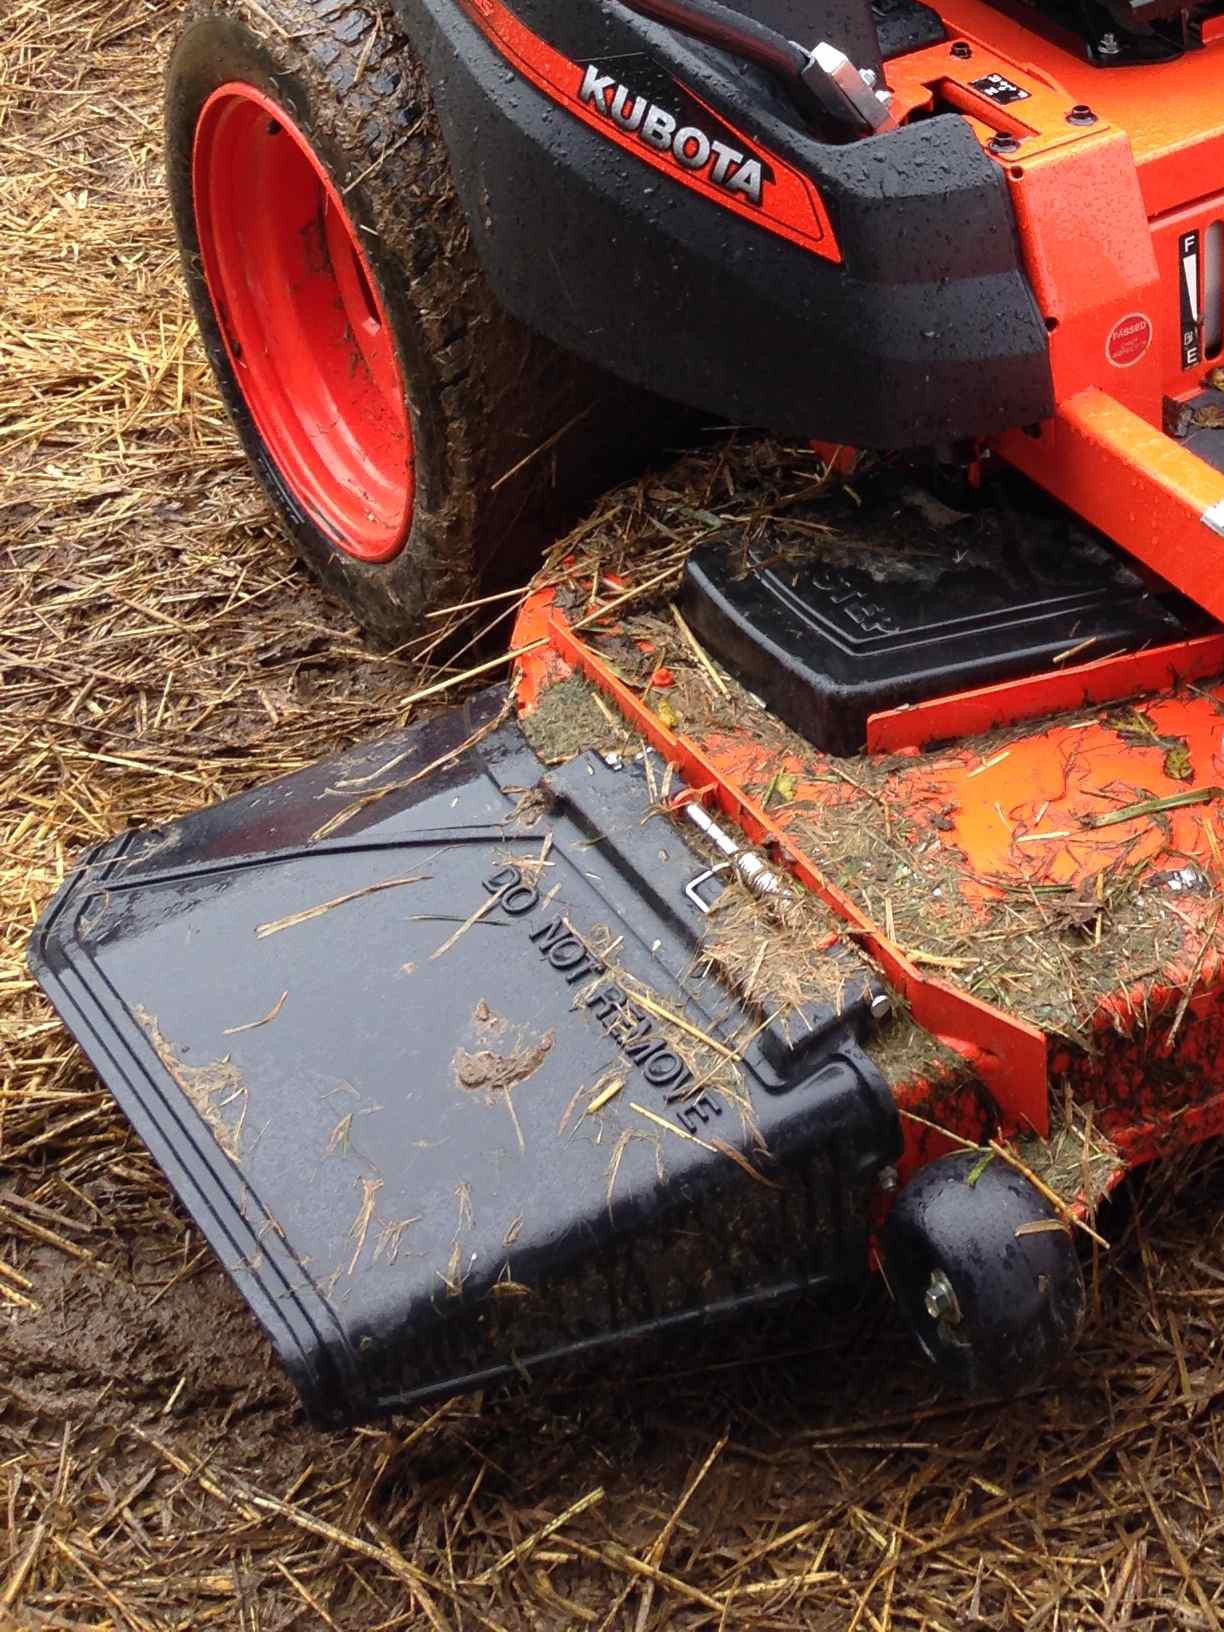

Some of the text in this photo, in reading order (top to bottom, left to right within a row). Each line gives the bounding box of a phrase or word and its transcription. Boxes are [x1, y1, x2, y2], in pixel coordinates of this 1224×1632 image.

[579, 63, 765, 208] KUBOTA
[1184, 235, 1195, 253] F
[1186, 347, 1198, 364] E
[482, 867, 724, 1135] DO NOT REMOVE
